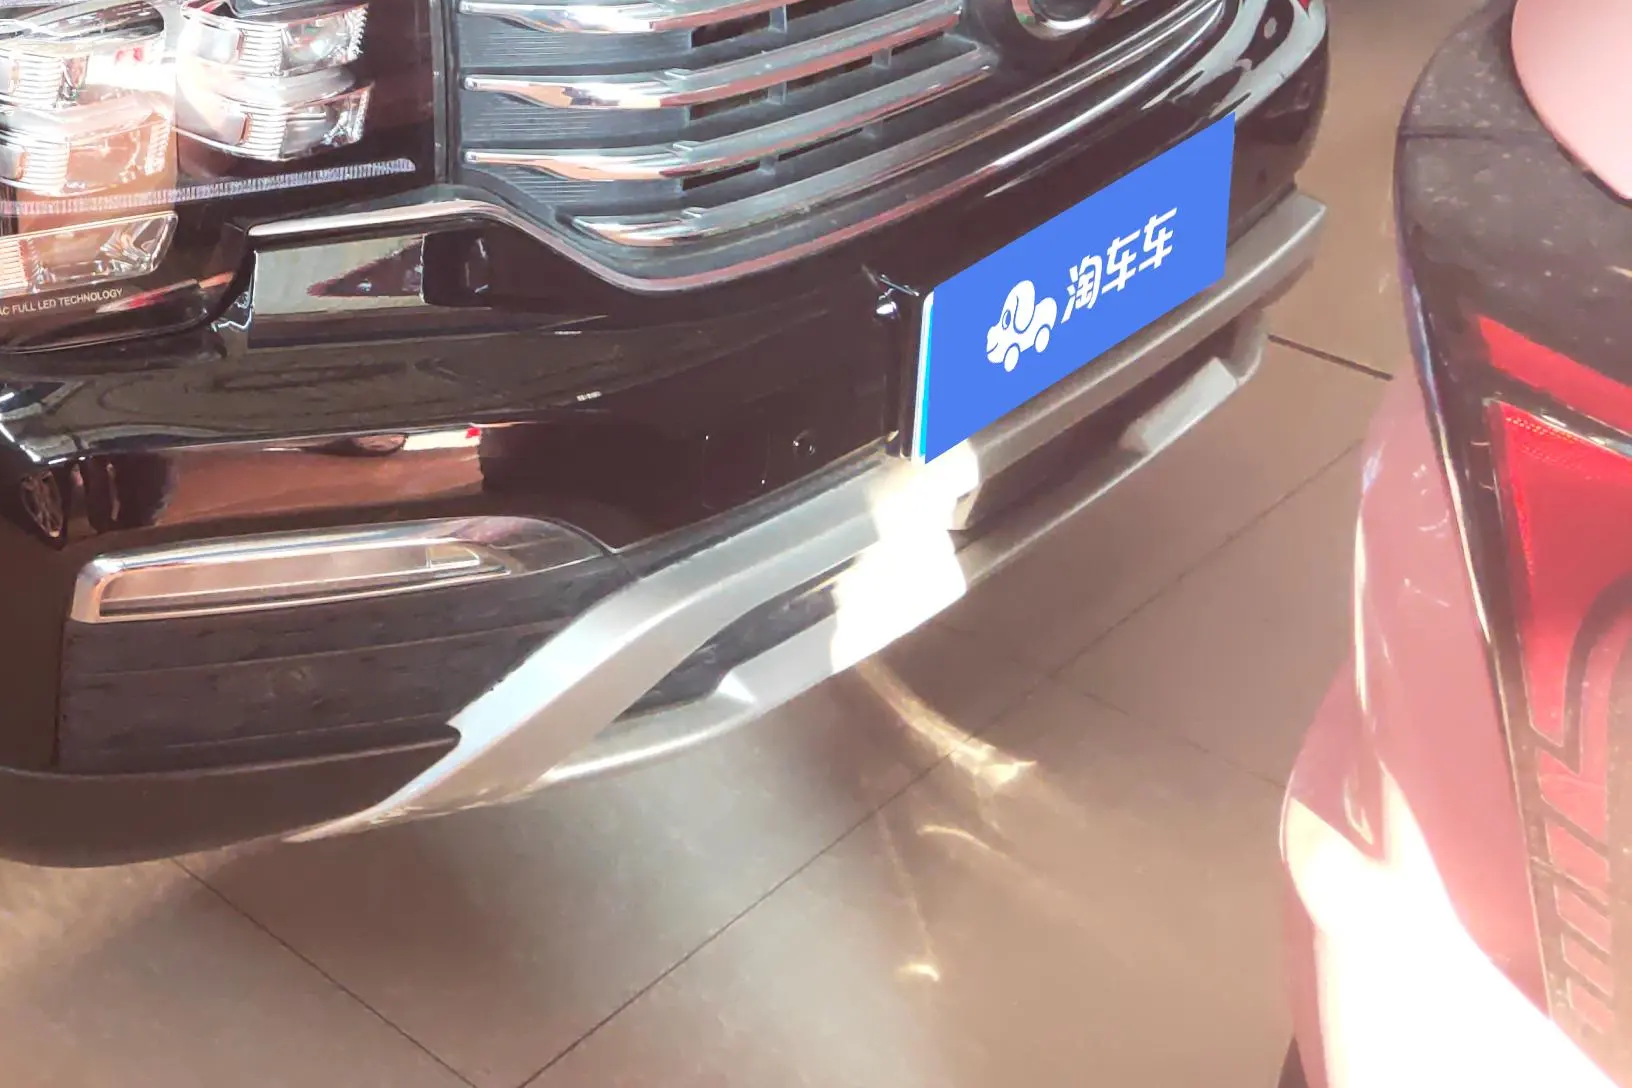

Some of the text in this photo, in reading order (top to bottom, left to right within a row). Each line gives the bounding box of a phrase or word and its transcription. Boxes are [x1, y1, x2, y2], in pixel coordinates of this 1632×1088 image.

[11, 302, 36, 315] FULL
[37, 299, 57, 311] LED
[58, 287, 125, 307] TECHNOLOGY
